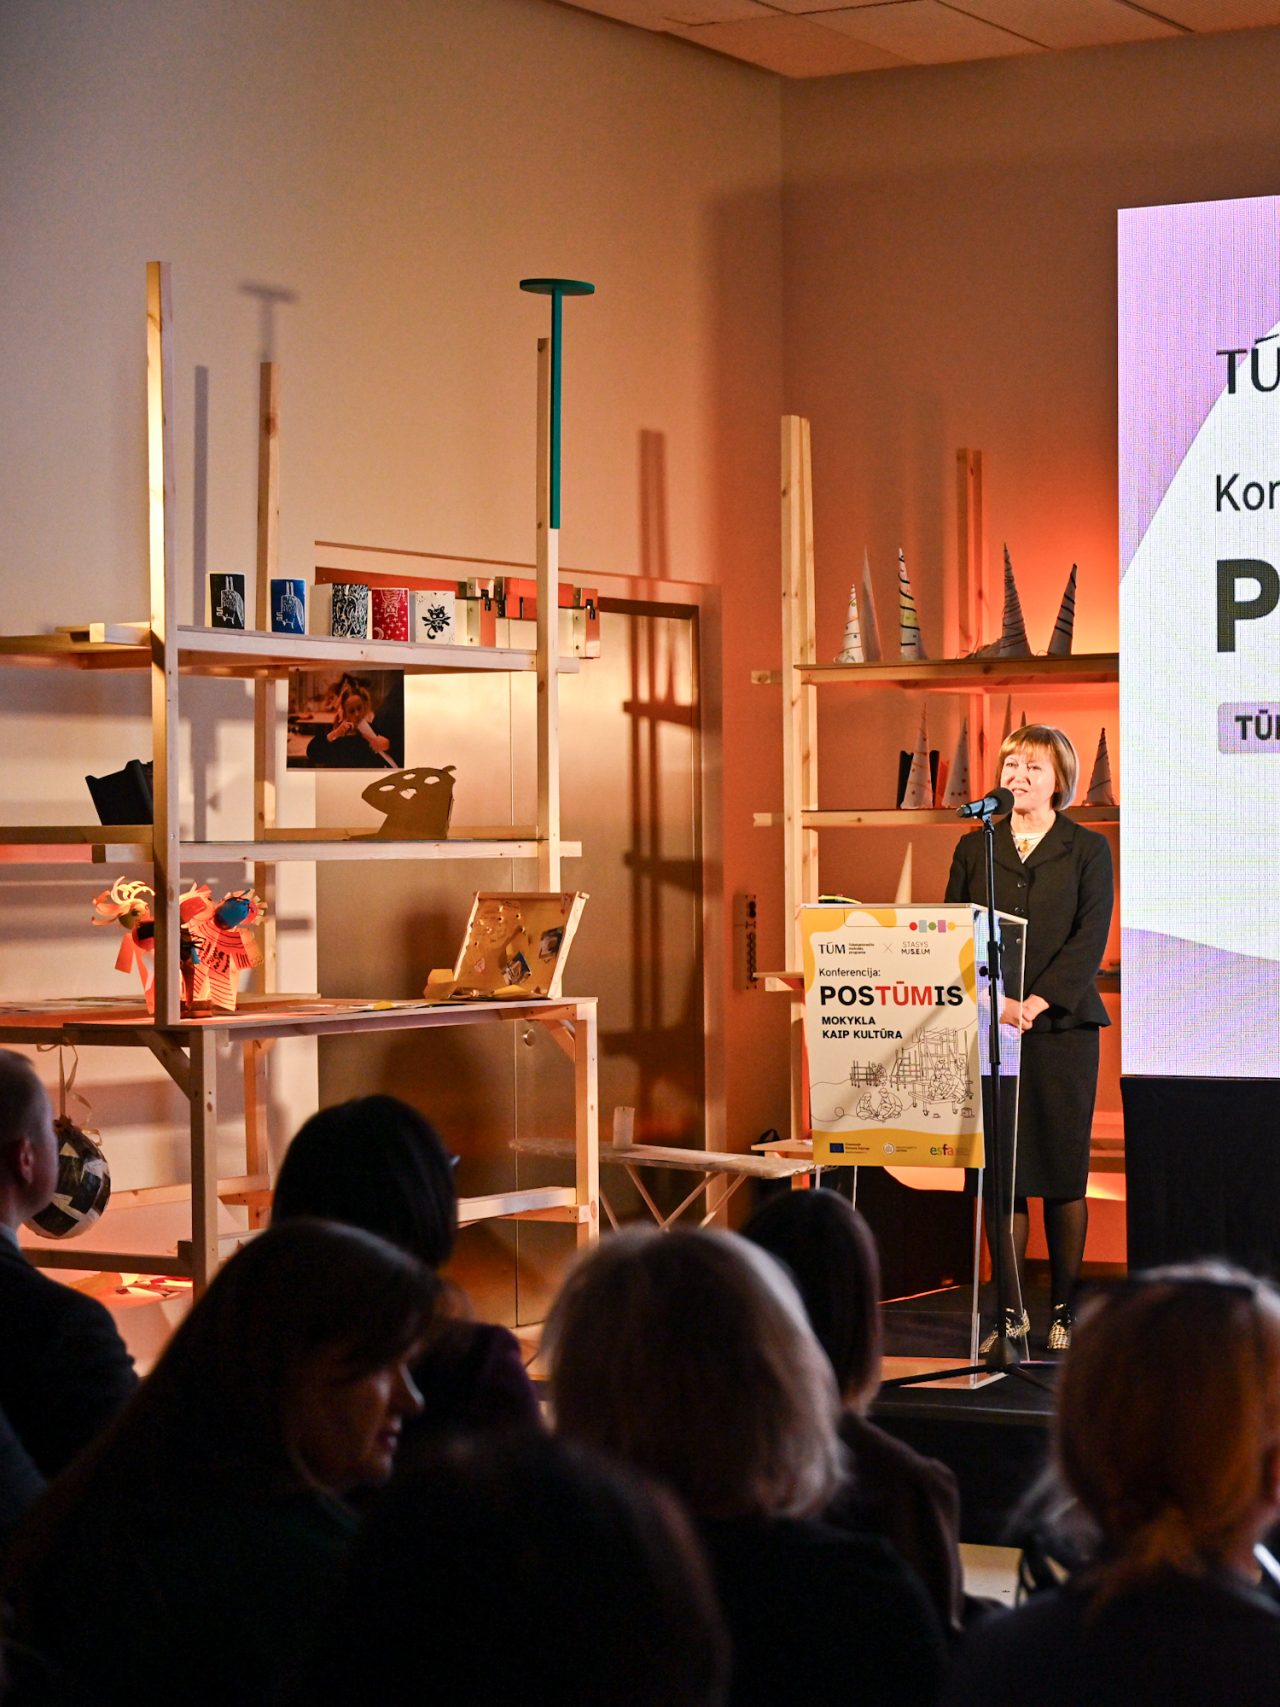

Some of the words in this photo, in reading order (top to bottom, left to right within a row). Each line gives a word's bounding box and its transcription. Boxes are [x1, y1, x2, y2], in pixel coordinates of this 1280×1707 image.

[818, 941, 846, 955] TŪM
[902, 941, 929, 949] STASYS
[819, 967, 881, 978] Konferencija:
[820, 981, 963, 1006] POSTŪMIS
[821, 1016, 876, 1025] MOKYKLA
[822, 1030, 850, 1039] KAIP
[853, 1028, 903, 1039] KULTŪRA
[929, 1143, 955, 1157] esfa
